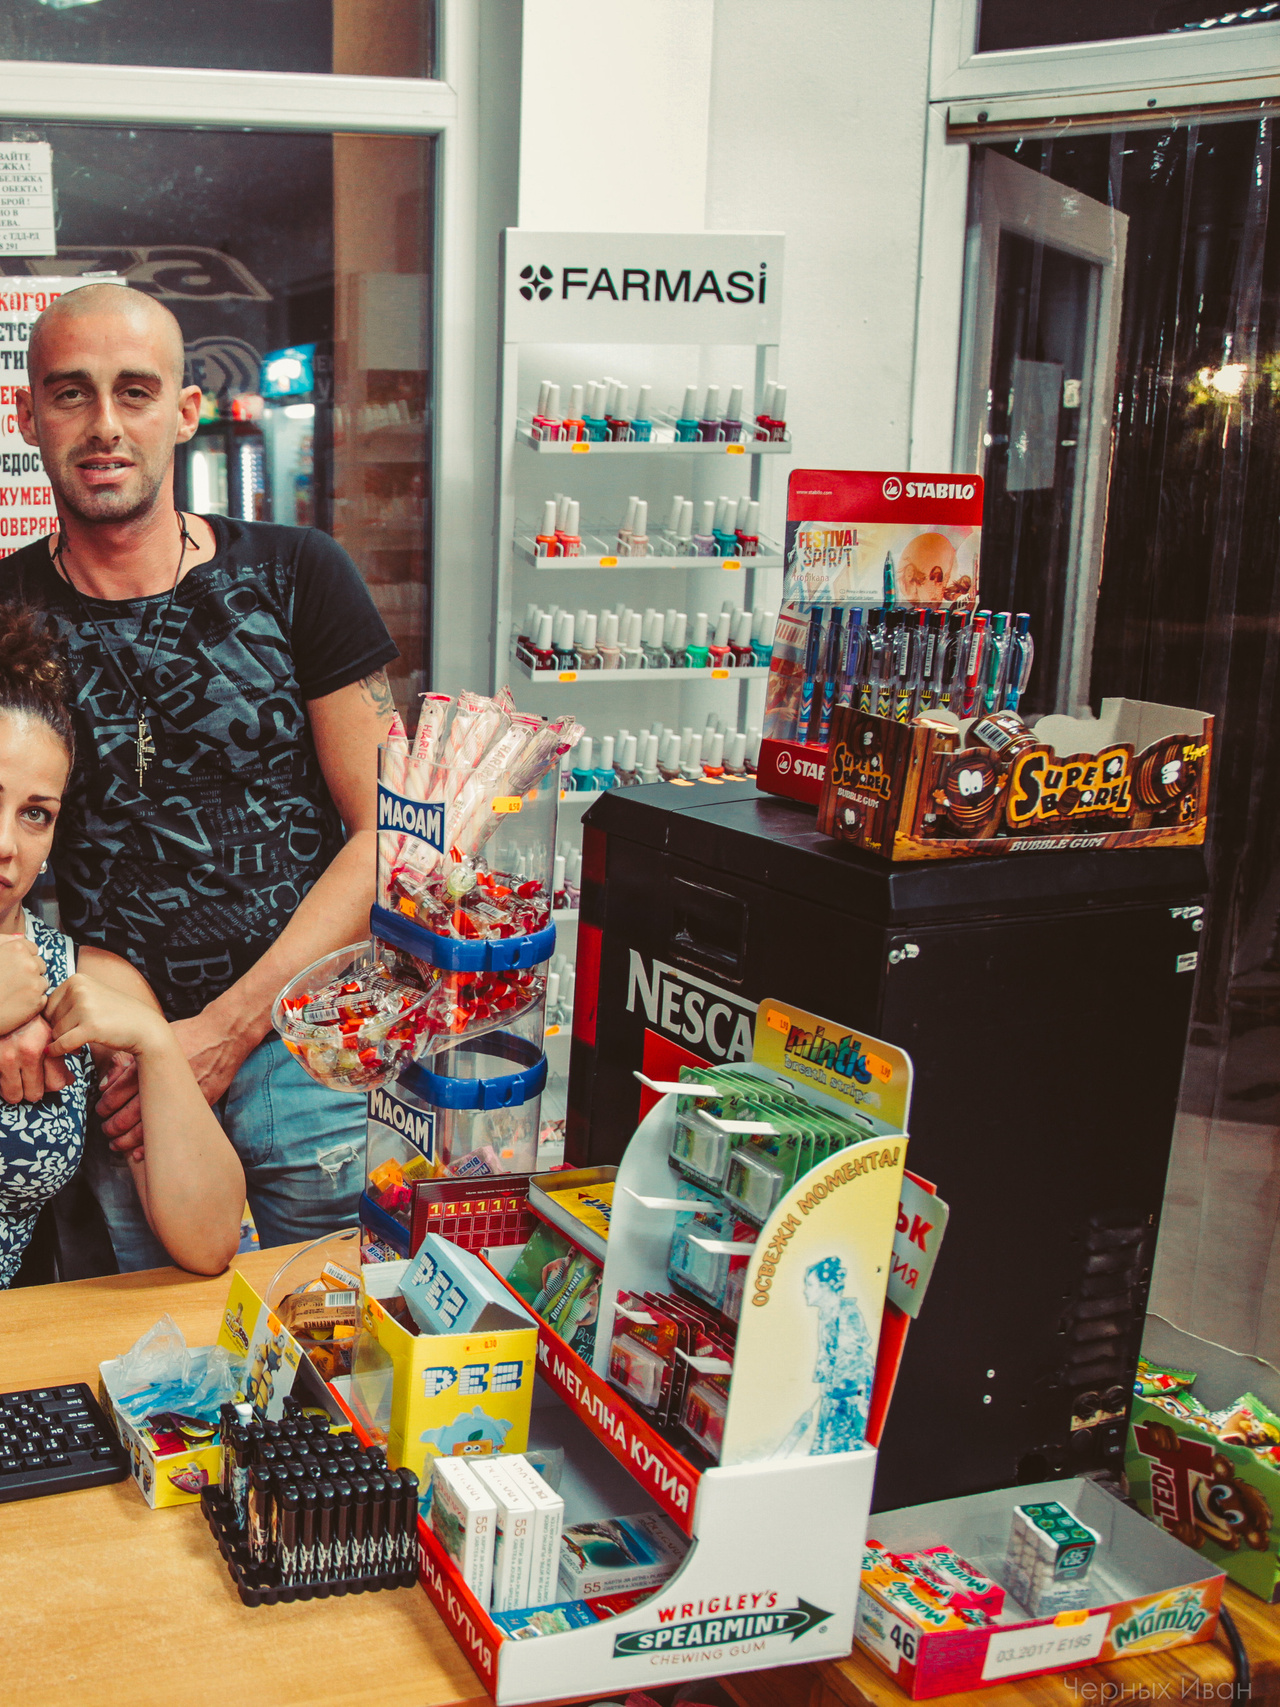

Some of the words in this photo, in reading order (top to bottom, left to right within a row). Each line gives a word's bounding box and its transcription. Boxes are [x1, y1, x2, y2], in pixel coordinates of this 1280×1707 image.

[906, 482, 975, 500] STABILO
[798, 529, 859, 548] FESTIVAL
[793, 573, 830, 583] tropikana
[837, 787, 862, 803] BUBBLE
[862, 796, 880, 808] GUM
[379, 793, 441, 846] MAOAM
[1009, 837, 1069, 851] BUBBLE
[1070, 836, 1106, 849] GUM
[626, 948, 758, 1063] NESCA
[784, 1053, 827, 1085] breath
[370, 1086, 429, 1153] MAOAM
[752, 1213, 802, 1307] ОСВЕЖИ
[797, 1146, 901, 1216] МОМЕНТА!
[550, 1271, 583, 1321] DOUBLEMINT
[421, 1360, 525, 1398] PEZ
[553, 1353, 627, 1450] МЕТАЛНА
[629, 1437, 691, 1513] КУТИЯ
[1150, 1461, 1178, 1521] TEDI
[475, 1516, 488, 1534] 55
[514, 1519, 527, 1537] 55
[583, 1582, 601, 1594] 55
[658, 1590, 779, 1623] WRIGLEY'S
[446, 1597, 493, 1676] КУТИЯ
[638, 1614, 789, 1650] SPEARMINT
[890, 1624, 916, 1660] 46
[1112, 1606, 1208, 1649] Mamba
[650, 1648, 723, 1666] CHEWING
[730, 1641, 767, 1658] GUM
